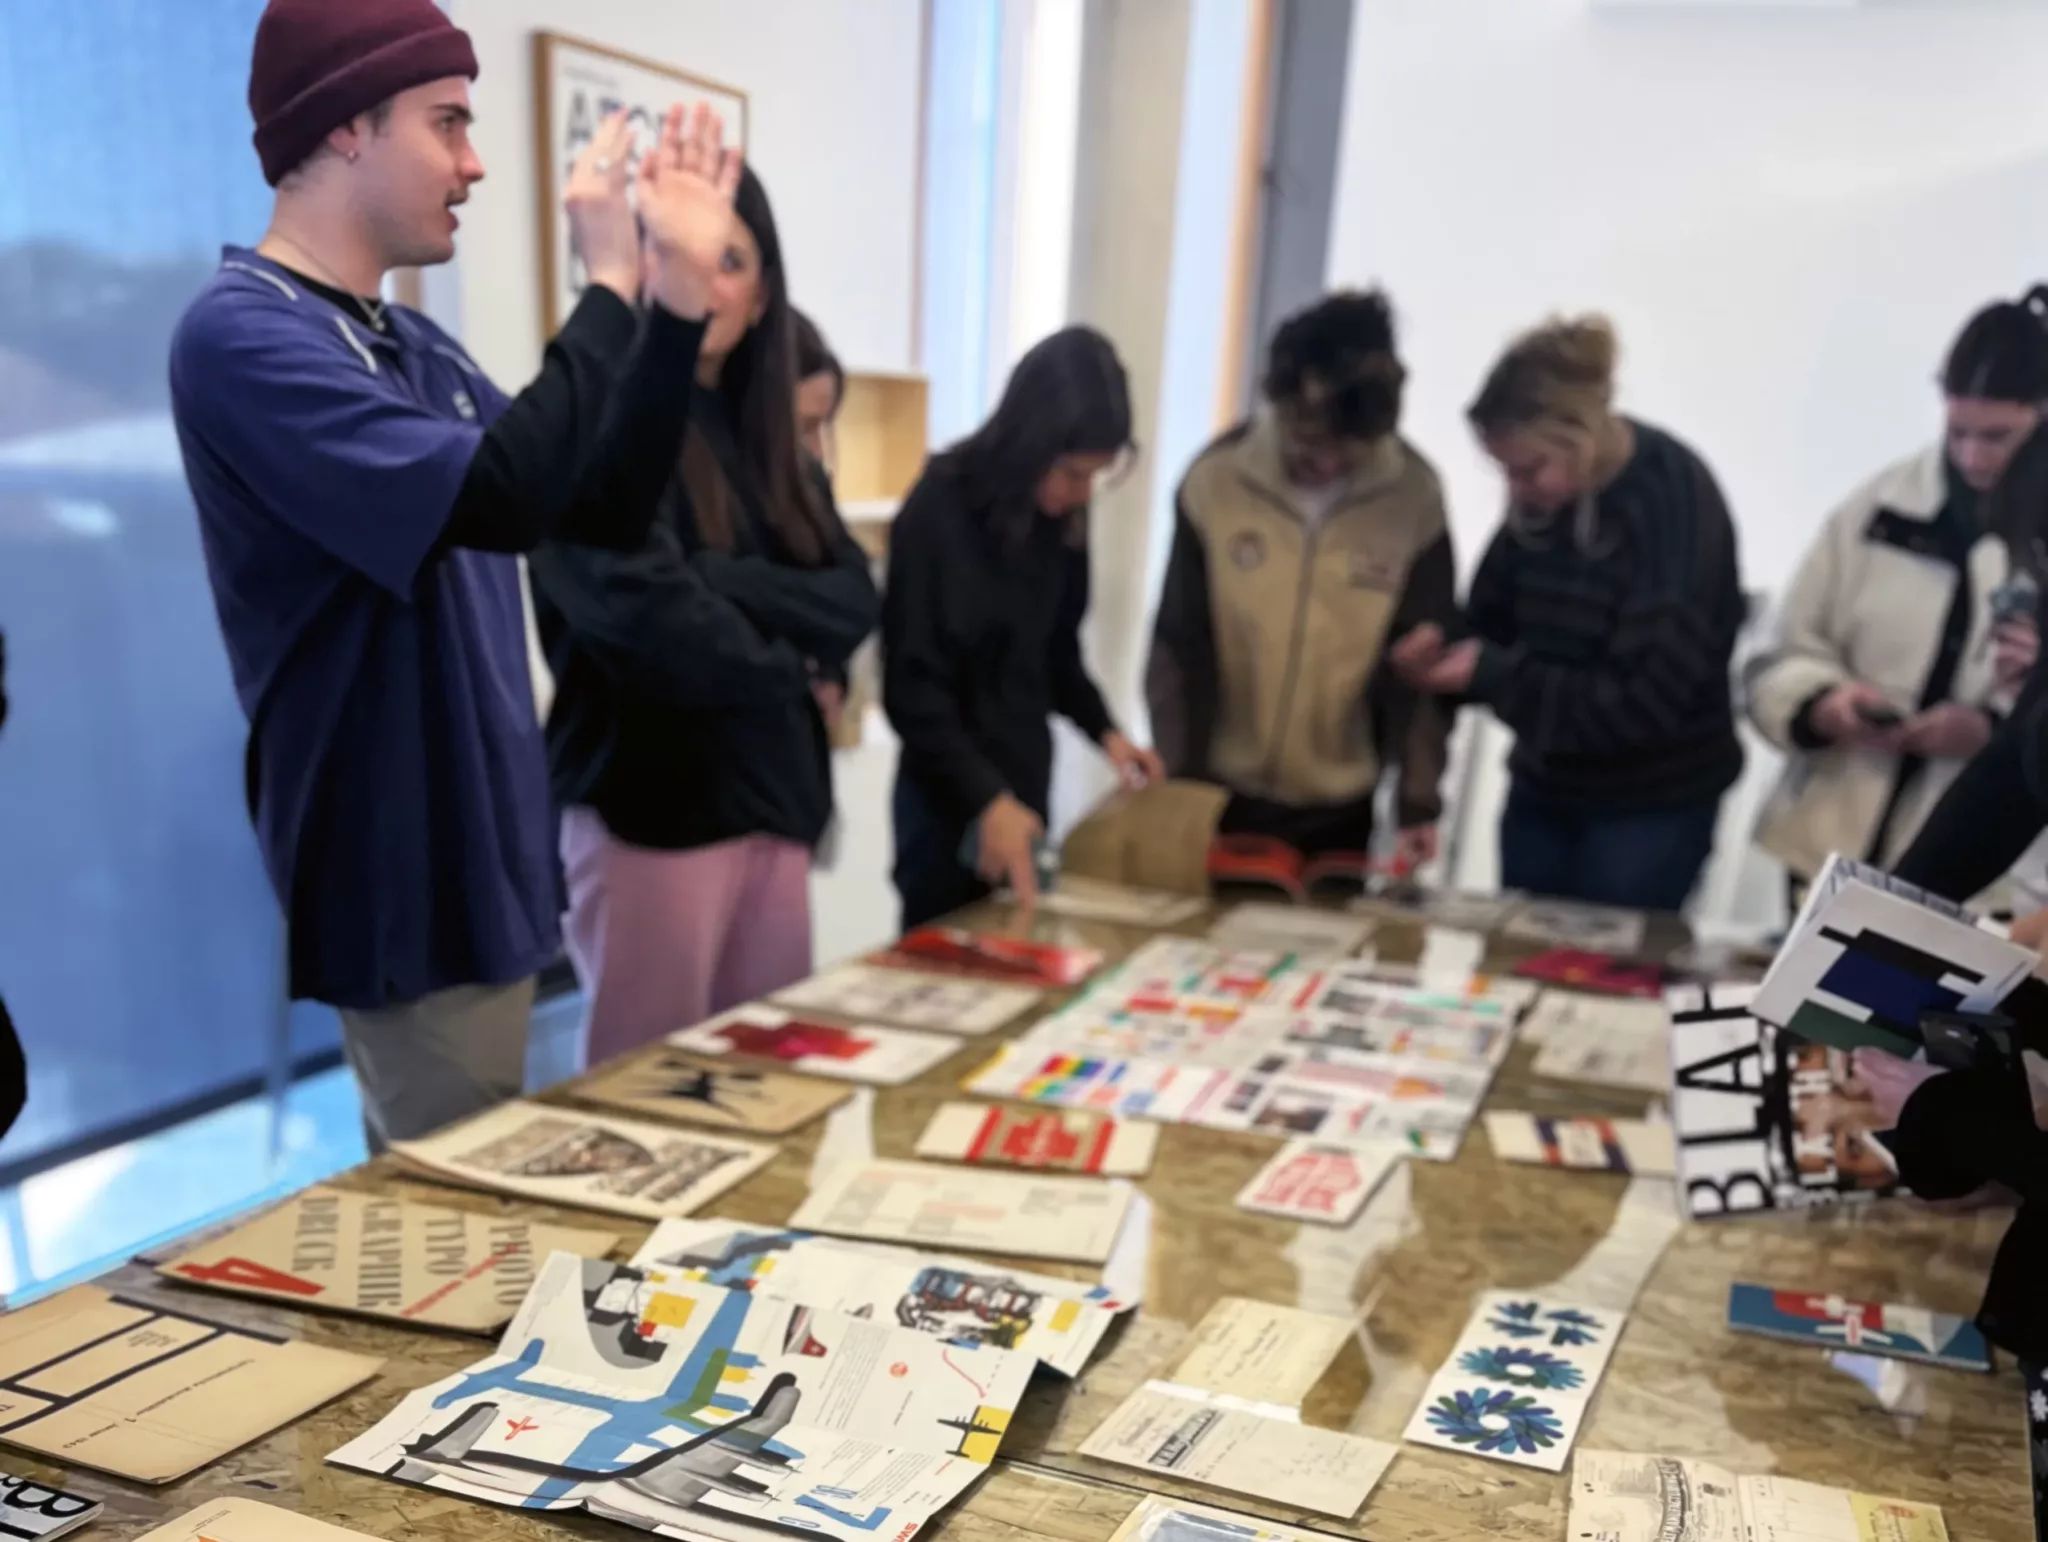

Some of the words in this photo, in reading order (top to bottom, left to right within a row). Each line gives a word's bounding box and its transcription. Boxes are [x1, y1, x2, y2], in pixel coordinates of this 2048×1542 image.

[357, 1200, 402, 1308] GRAPHIK
[424, 1210, 467, 1277] TYPO
[488, 1223, 533, 1306] PHOTO
